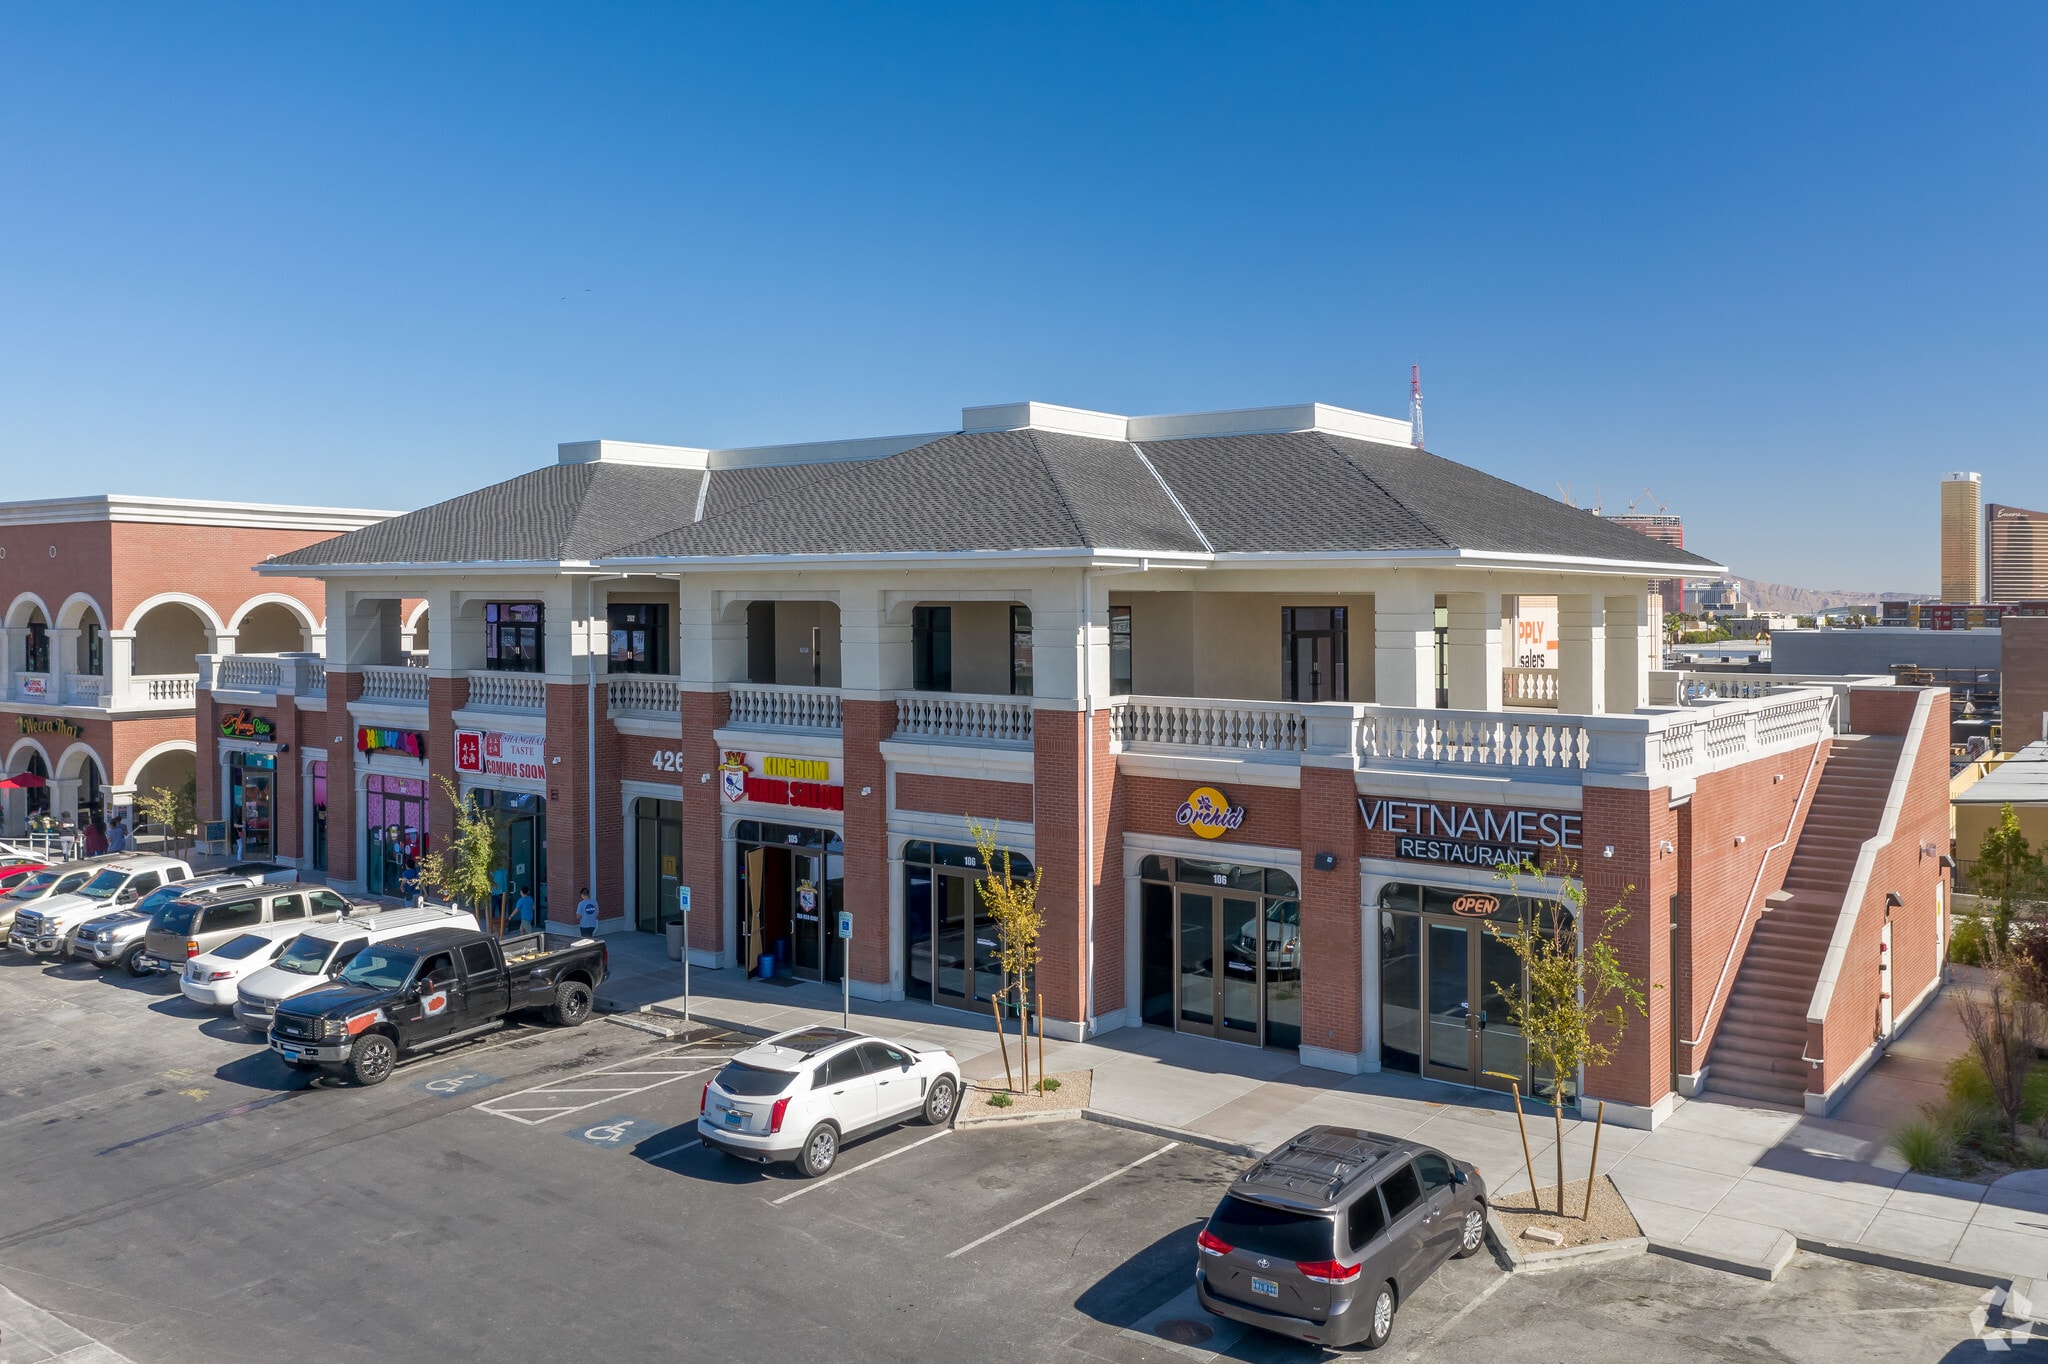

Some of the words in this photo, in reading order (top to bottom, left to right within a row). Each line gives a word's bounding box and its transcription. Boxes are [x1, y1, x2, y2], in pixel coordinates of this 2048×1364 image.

[1997, 508, 2028, 518] Encore
[502, 733, 545, 746] SHANGHAI
[511, 745, 535, 756] TASTE
[486, 759, 518, 777] COMING
[519, 763, 546, 780] SOON
[763, 757, 829, 780] KINGDOM
[748, 777, 789, 805] HAIR
[789, 781, 844, 811] SALON
[1175, 801, 1244, 829] Orchid
[1357, 798, 1583, 849] VIETNAMESE
[787, 834, 798, 844] 105
[964, 856, 976, 867] 106
[1401, 839, 1534, 867] RESTAURANT
[1213, 874, 1228, 885] 106
[1454, 897, 1496, 915] OPEN
